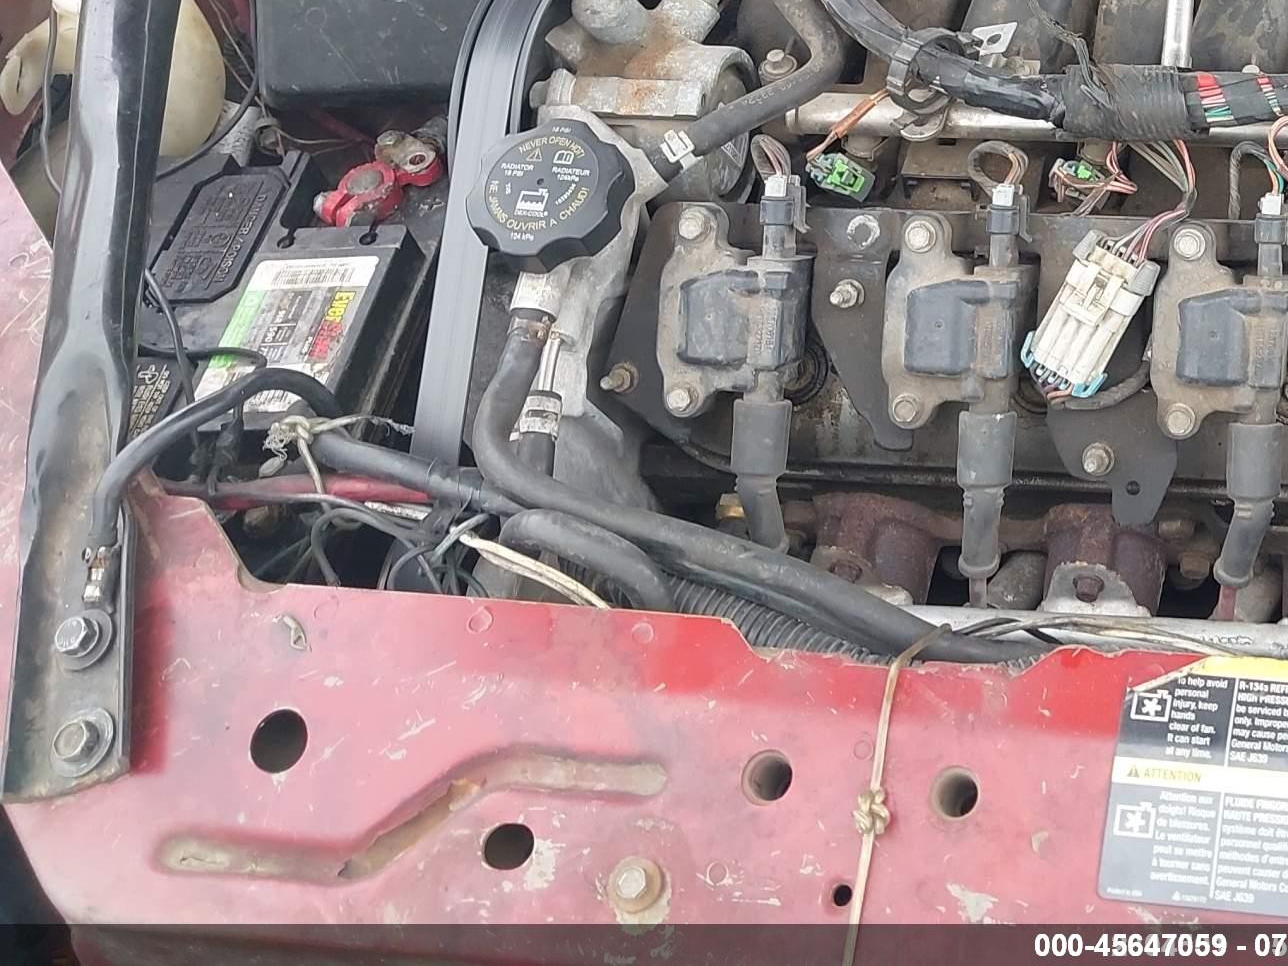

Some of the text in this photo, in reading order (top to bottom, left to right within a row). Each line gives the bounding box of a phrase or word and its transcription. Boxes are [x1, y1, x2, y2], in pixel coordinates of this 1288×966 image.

[519, 137, 548, 153] NEVER
[549, 136, 572, 148] OPEN
[552, 167, 590, 176] RADIATEUR
[507, 219, 546, 231] OUVRIR
[1187, 677, 1205, 687] help
[1206, 679, 1228, 688] avoid
[1239, 681, 1269, 692] R-134a
[1175, 689, 1209, 698] personal
[1238, 693, 1257, 702] HIGH
[1173, 699, 1218, 712] injury, keep
[1236, 704, 1246, 713] be
[1248, 706, 1282, 717] serviced
[1171, 710, 1196, 720] hands
[1169, 722, 1216, 734] clear of fan.
[1175, 735, 1210, 745] can start
[1233, 729, 1250, 740] may
[1252, 730, 1276, 739] cause
[1231, 739, 1261, 750] General
[1165, 746, 1175, 755] at
[1175, 748, 1191, 760] any
[1230, 751, 1246, 761] SAE
[1144, 768, 1201, 782] ATTENTION
[1160, 791, 1197, 803] Attention
[1225, 796, 1254, 808] FLUIDE
[1224, 810, 1251, 821] HAUTE
[1156, 818, 1168, 826] de
[1155, 830, 1166, 840] Le
[1258, 826, 1274, 838] doit
[1153, 845, 1172, 855] peut
[1191, 861, 1211, 872] sans
[1217, 864, 1251, 876] peuvent
[1253, 868, 1281, 879] causer
[1216, 877, 1248, 888] General
[1249, 879, 1277, 891] Motors
[1215, 890, 1232, 902] SAE
